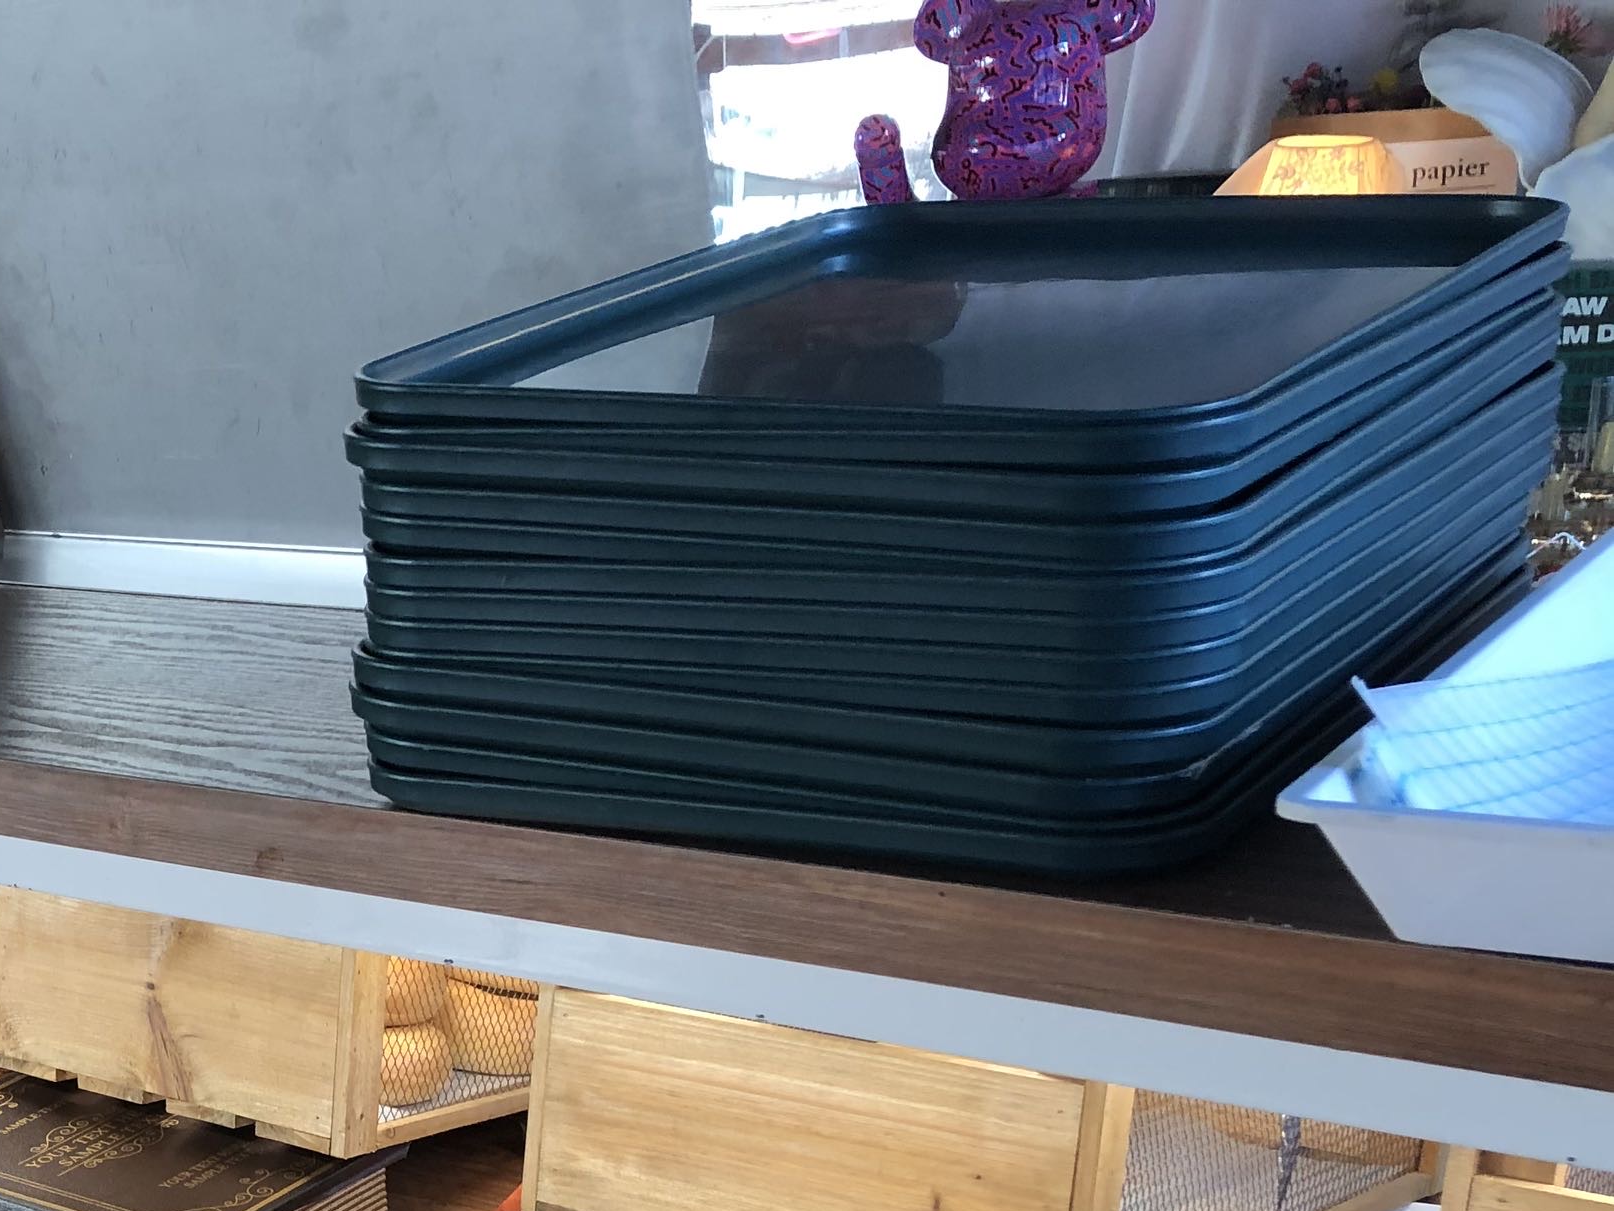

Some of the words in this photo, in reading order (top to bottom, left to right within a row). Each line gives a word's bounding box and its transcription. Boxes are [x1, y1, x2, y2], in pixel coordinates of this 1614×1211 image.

[1412, 158, 1490, 188] papier
[1561, 296, 1608, 317] AW
[24, 1143, 77, 1169] YOUR
[72, 1121, 117, 1146] TEXT
[58, 1132, 126, 1168] SAMPLE
